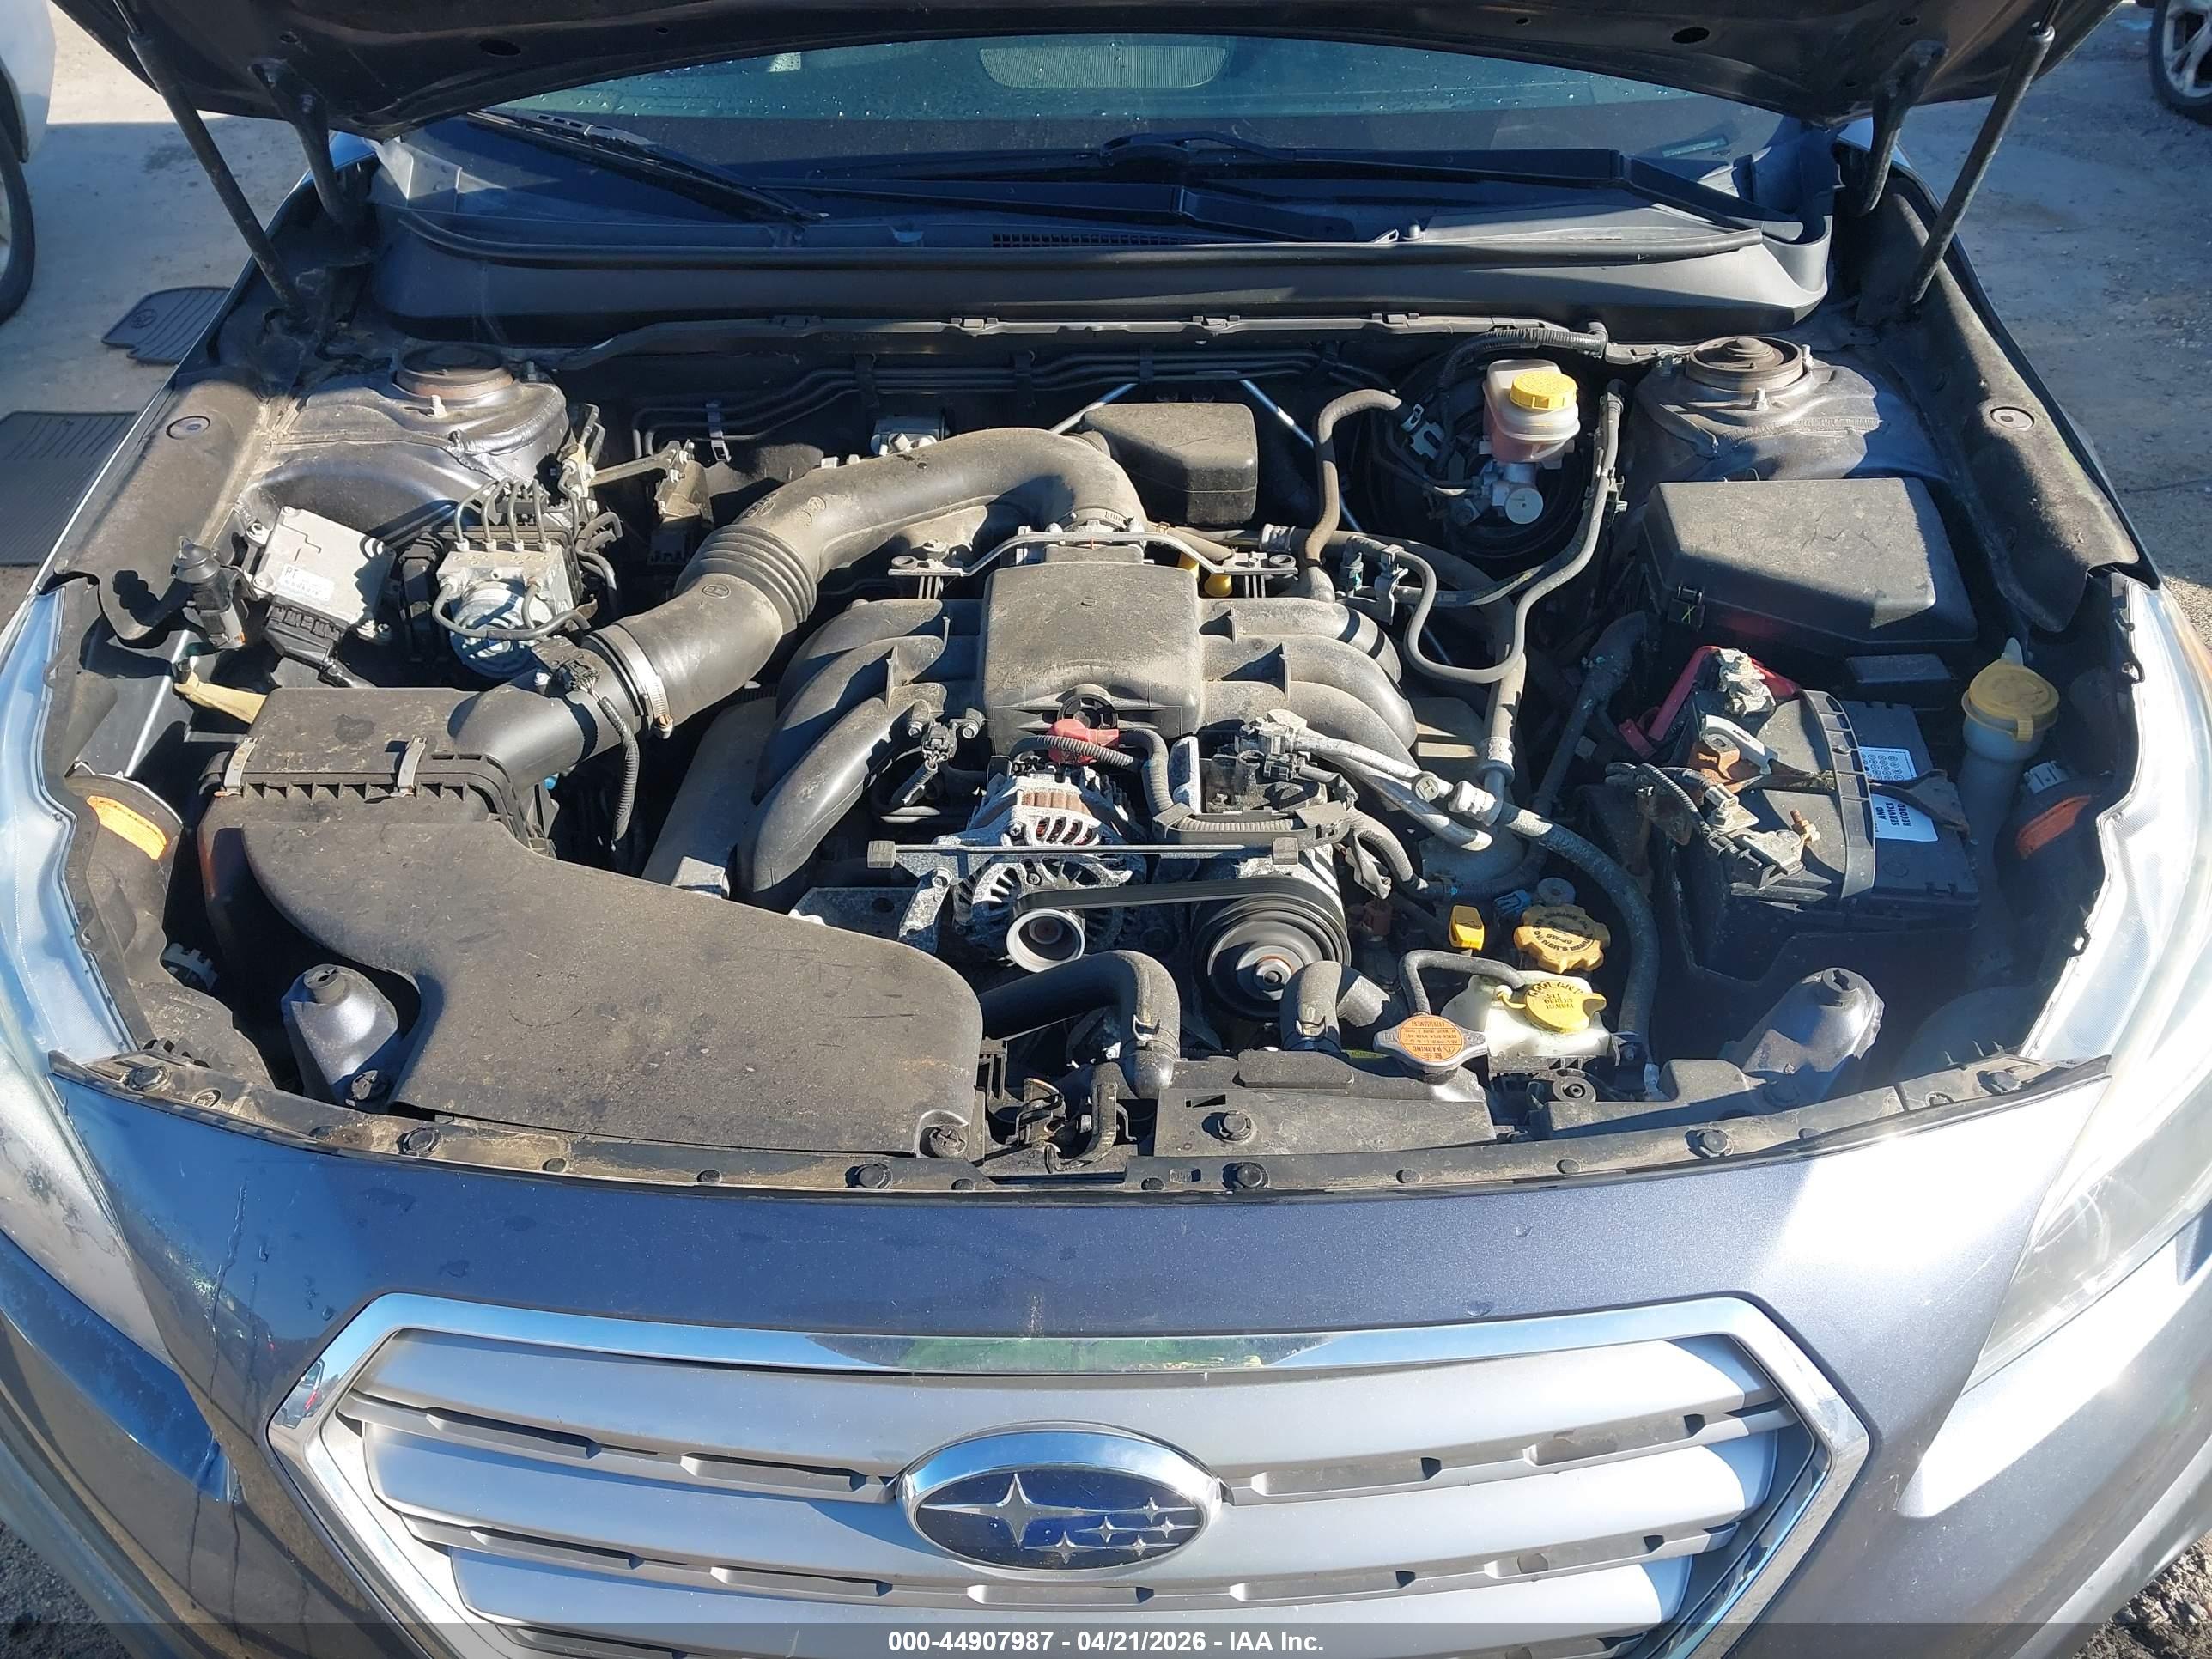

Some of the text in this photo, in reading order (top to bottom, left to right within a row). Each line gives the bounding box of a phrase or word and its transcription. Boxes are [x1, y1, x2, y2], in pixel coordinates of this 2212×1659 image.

[1875, 806, 1887, 820] AND
[1886, 802, 1900, 826] SERVICE
[1897, 804, 1911, 826] RECORD
